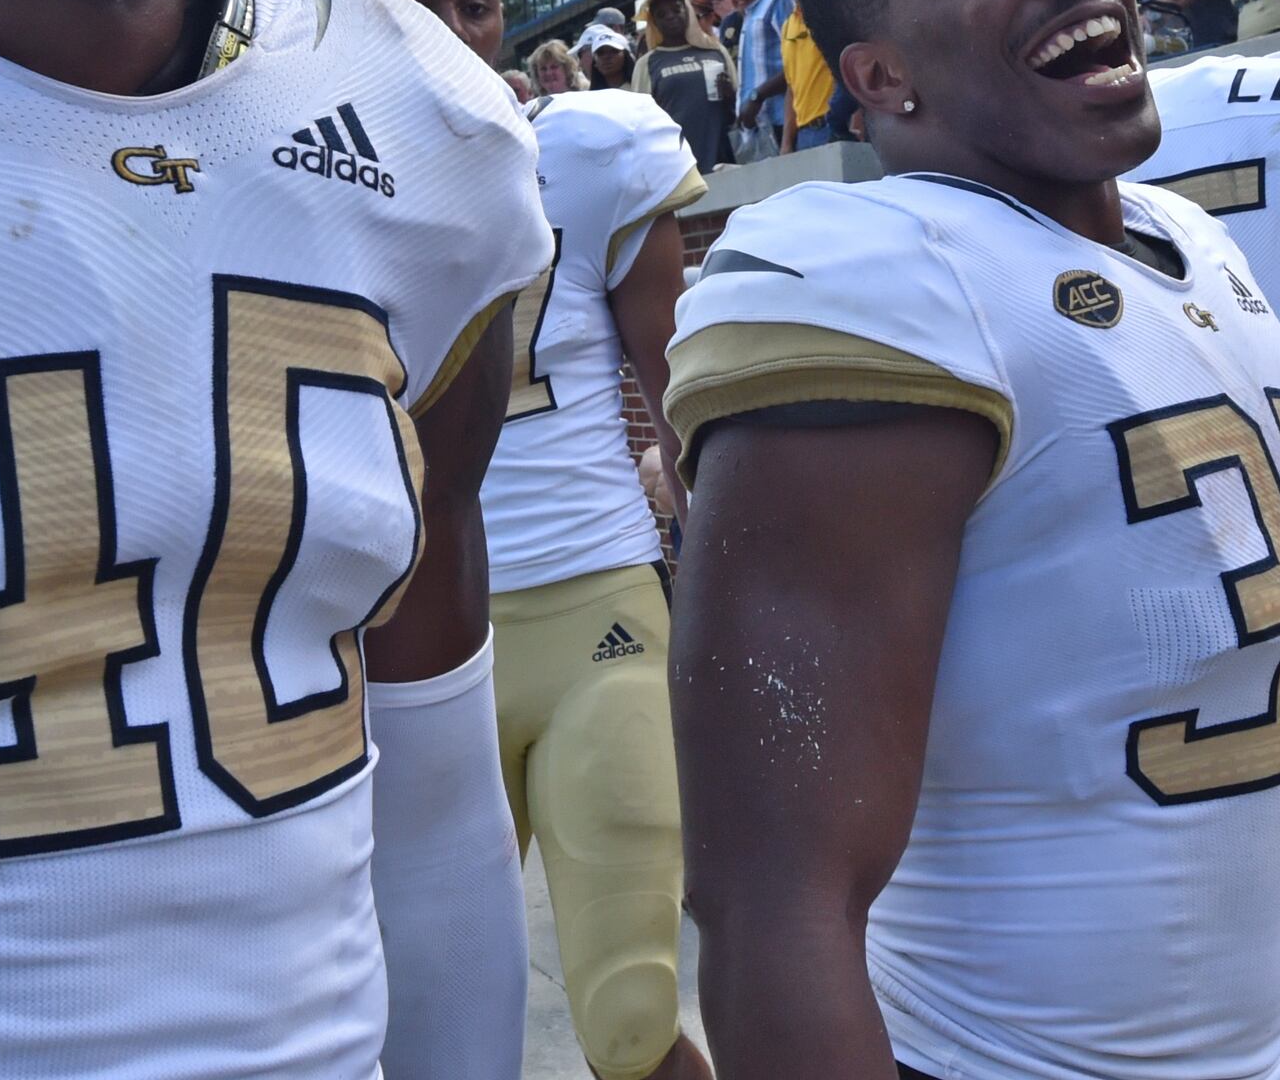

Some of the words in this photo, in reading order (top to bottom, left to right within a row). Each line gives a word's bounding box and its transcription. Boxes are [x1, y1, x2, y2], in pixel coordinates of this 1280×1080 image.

[110, 144, 202, 195] GT
[271, 144, 396, 199] adidas
[1067, 279, 1112, 311] ACC
[591, 642, 645, 663] adidas
